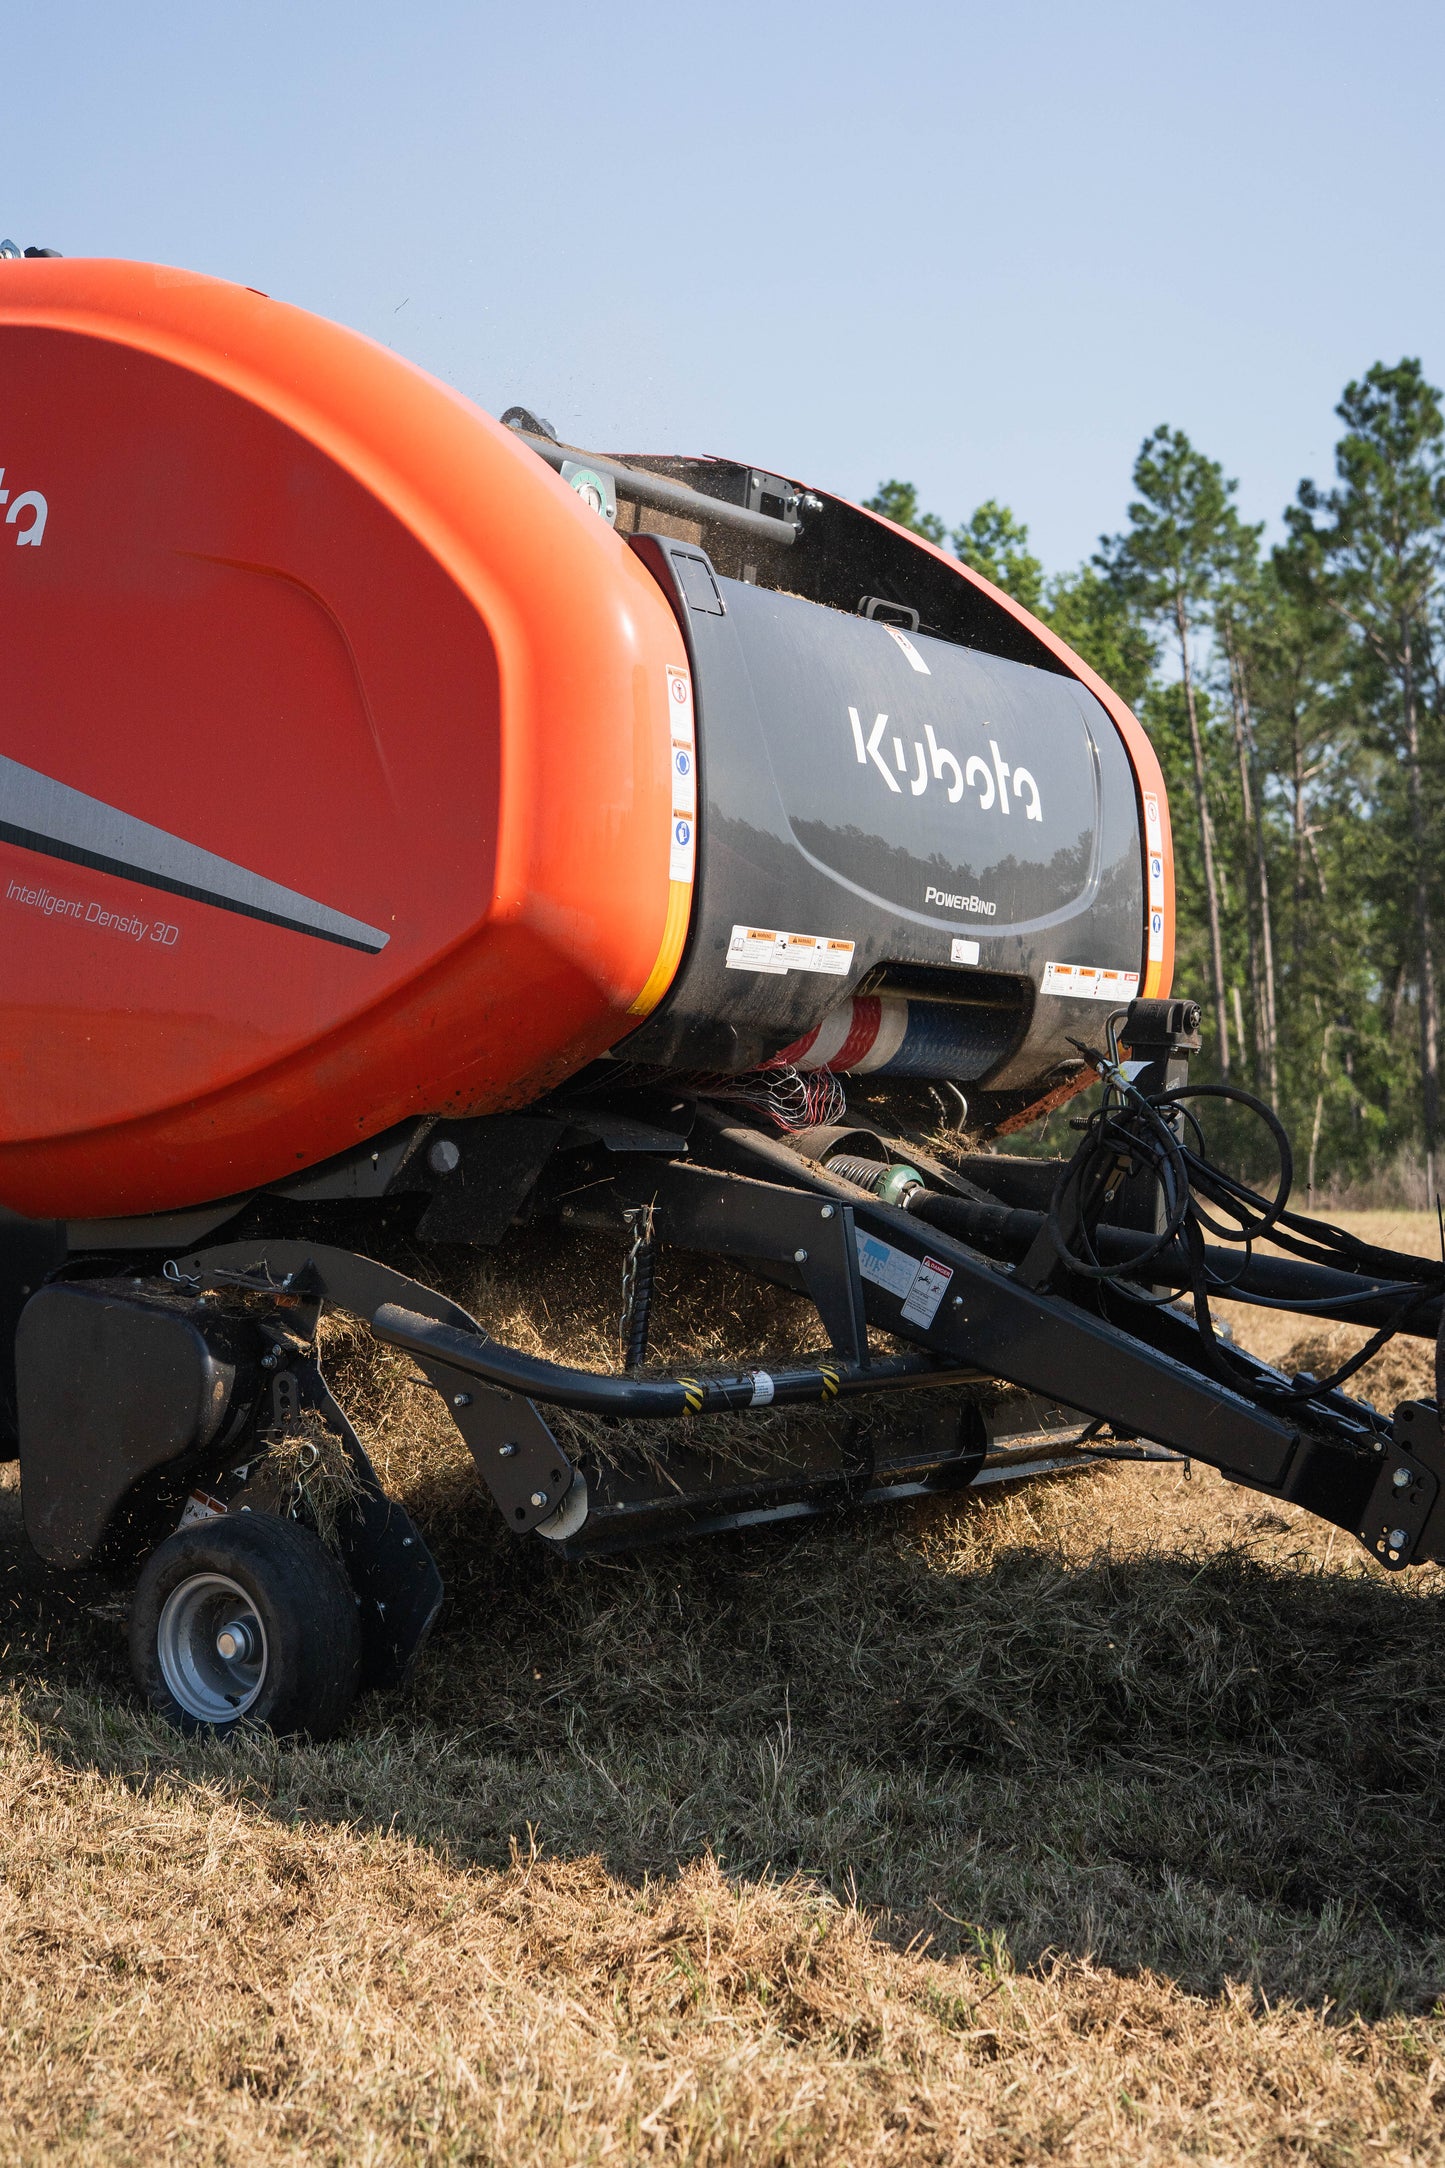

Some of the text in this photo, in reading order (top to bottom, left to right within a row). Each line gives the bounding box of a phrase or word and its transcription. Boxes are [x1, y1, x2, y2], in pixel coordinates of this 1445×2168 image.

[848, 706, 1043, 823] Kubota
[6, 880, 179, 946] Intelligent Density 3D
[930, 1263, 951, 1277] DANGER
